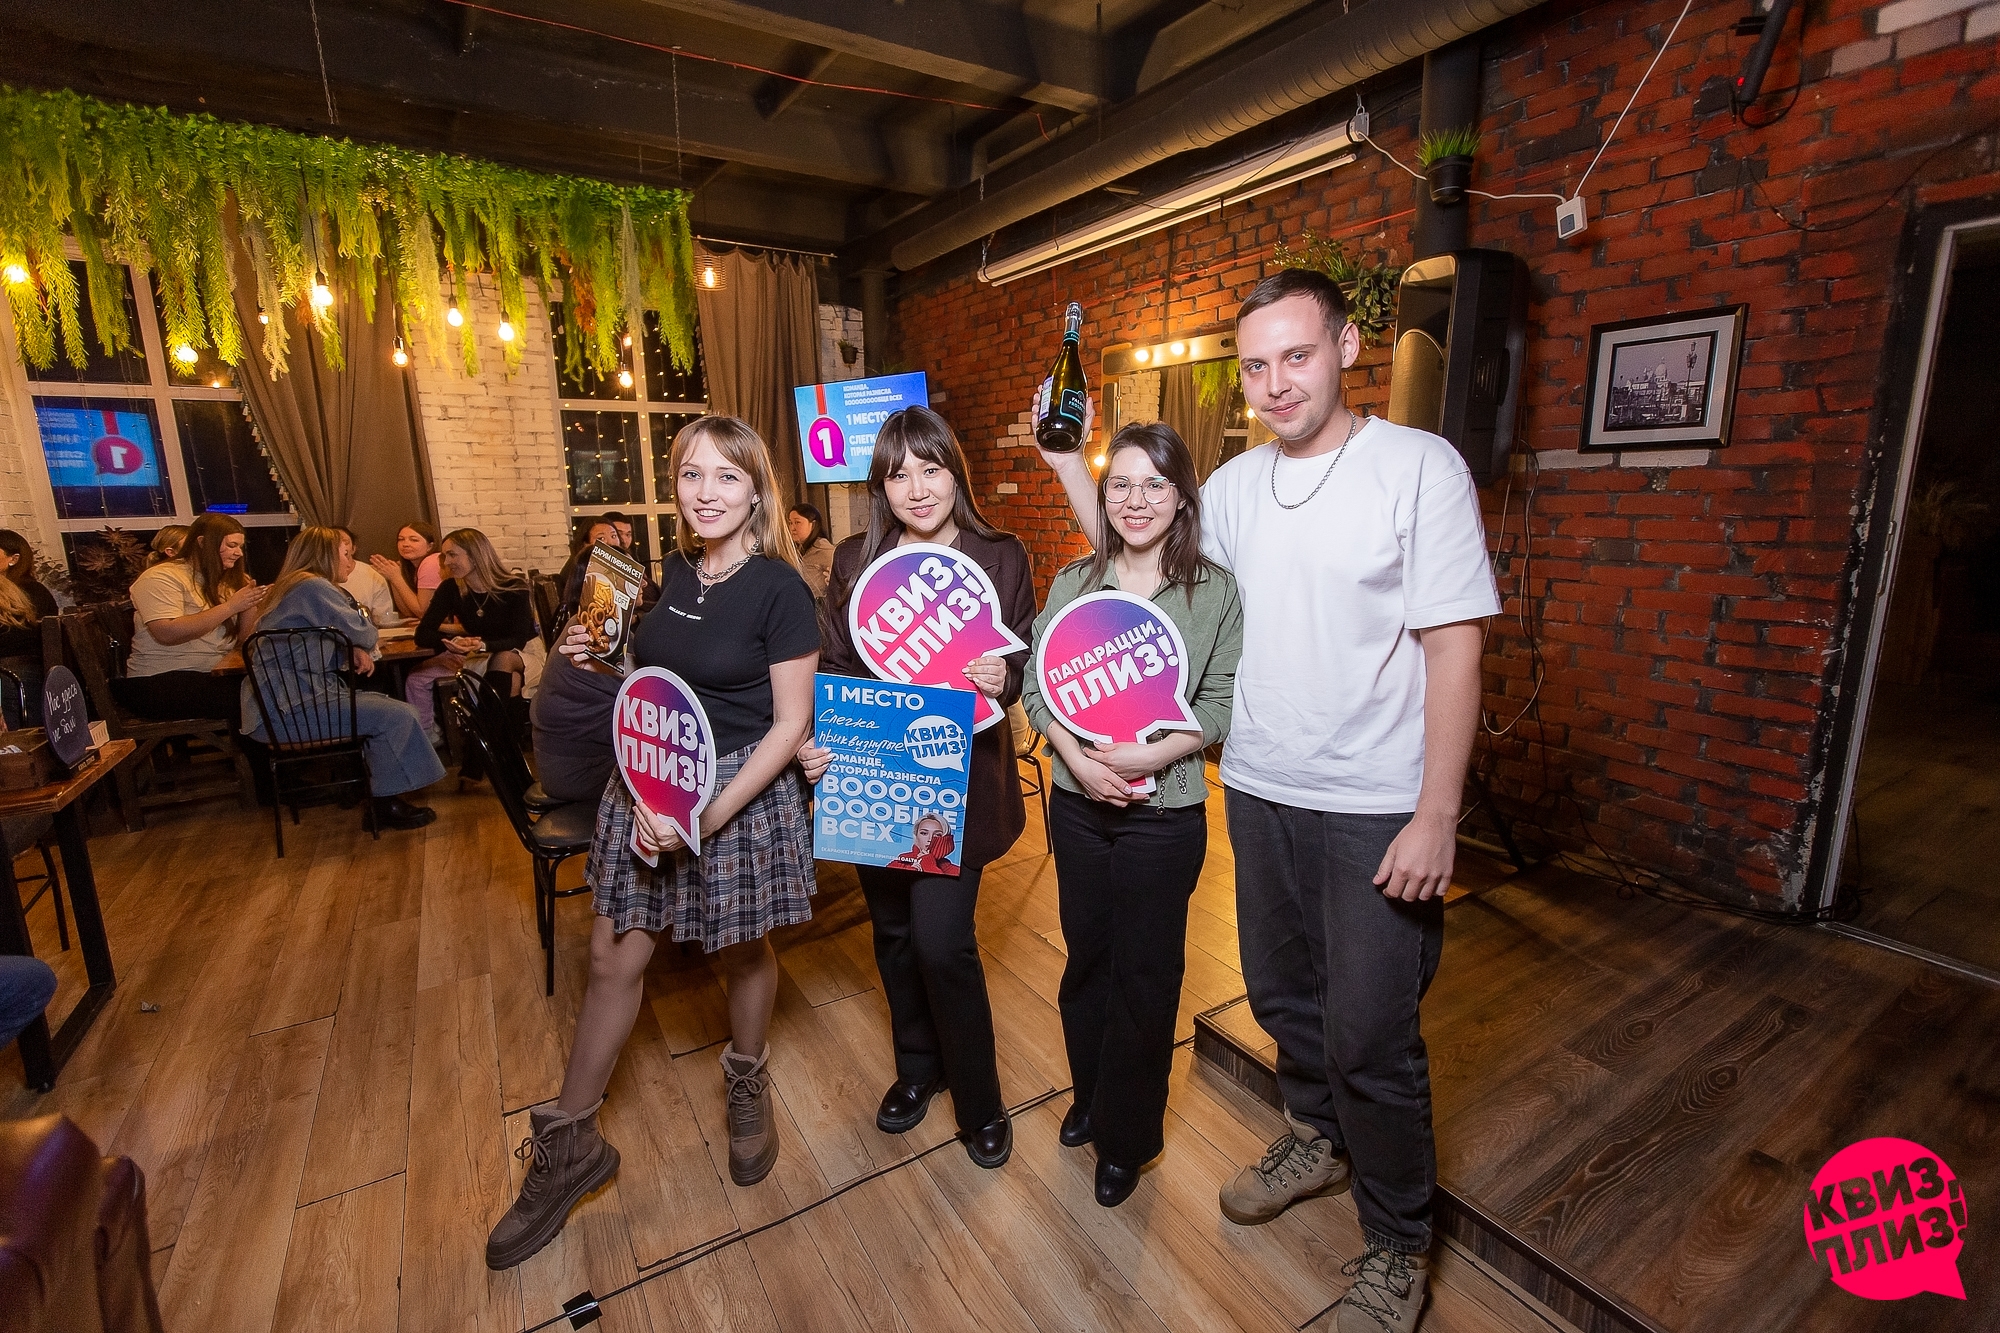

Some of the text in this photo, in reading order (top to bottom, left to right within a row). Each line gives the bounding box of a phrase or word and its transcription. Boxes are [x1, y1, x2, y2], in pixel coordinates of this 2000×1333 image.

[846, 410, 888, 425] 1 МЕСТО
[816, 427, 834, 460] 1
[592, 546, 611, 561] ДАРИМ
[611, 556, 632, 574] ПИВНОЙ
[631, 568, 642, 579] СЕТ
[858, 556, 968, 655] КВИЗ,
[884, 574, 991, 683] ПЛИЗ!
[1047, 620, 1163, 685] ПАПАРАЦЦИ,
[1056, 634, 1179, 717] ПЛИЗ!
[824, 684, 925, 710] 1 МЕСТО
[623, 694, 706, 761] КВИЗ,
[818, 709, 880, 729] Слегка
[906, 724, 965, 744] КВИЗ,
[620, 733, 706, 797] ПЛИЗ!
[831, 752, 885, 769] ОМАНДЕ,
[907, 740, 966, 759] ПЛИЗ!
[826, 763, 942, 786] ОТОРАЯ РАЗНЕСЛА
[823, 774, 967, 809] ВООООО
[822, 816, 895, 843] ВСЕХ
